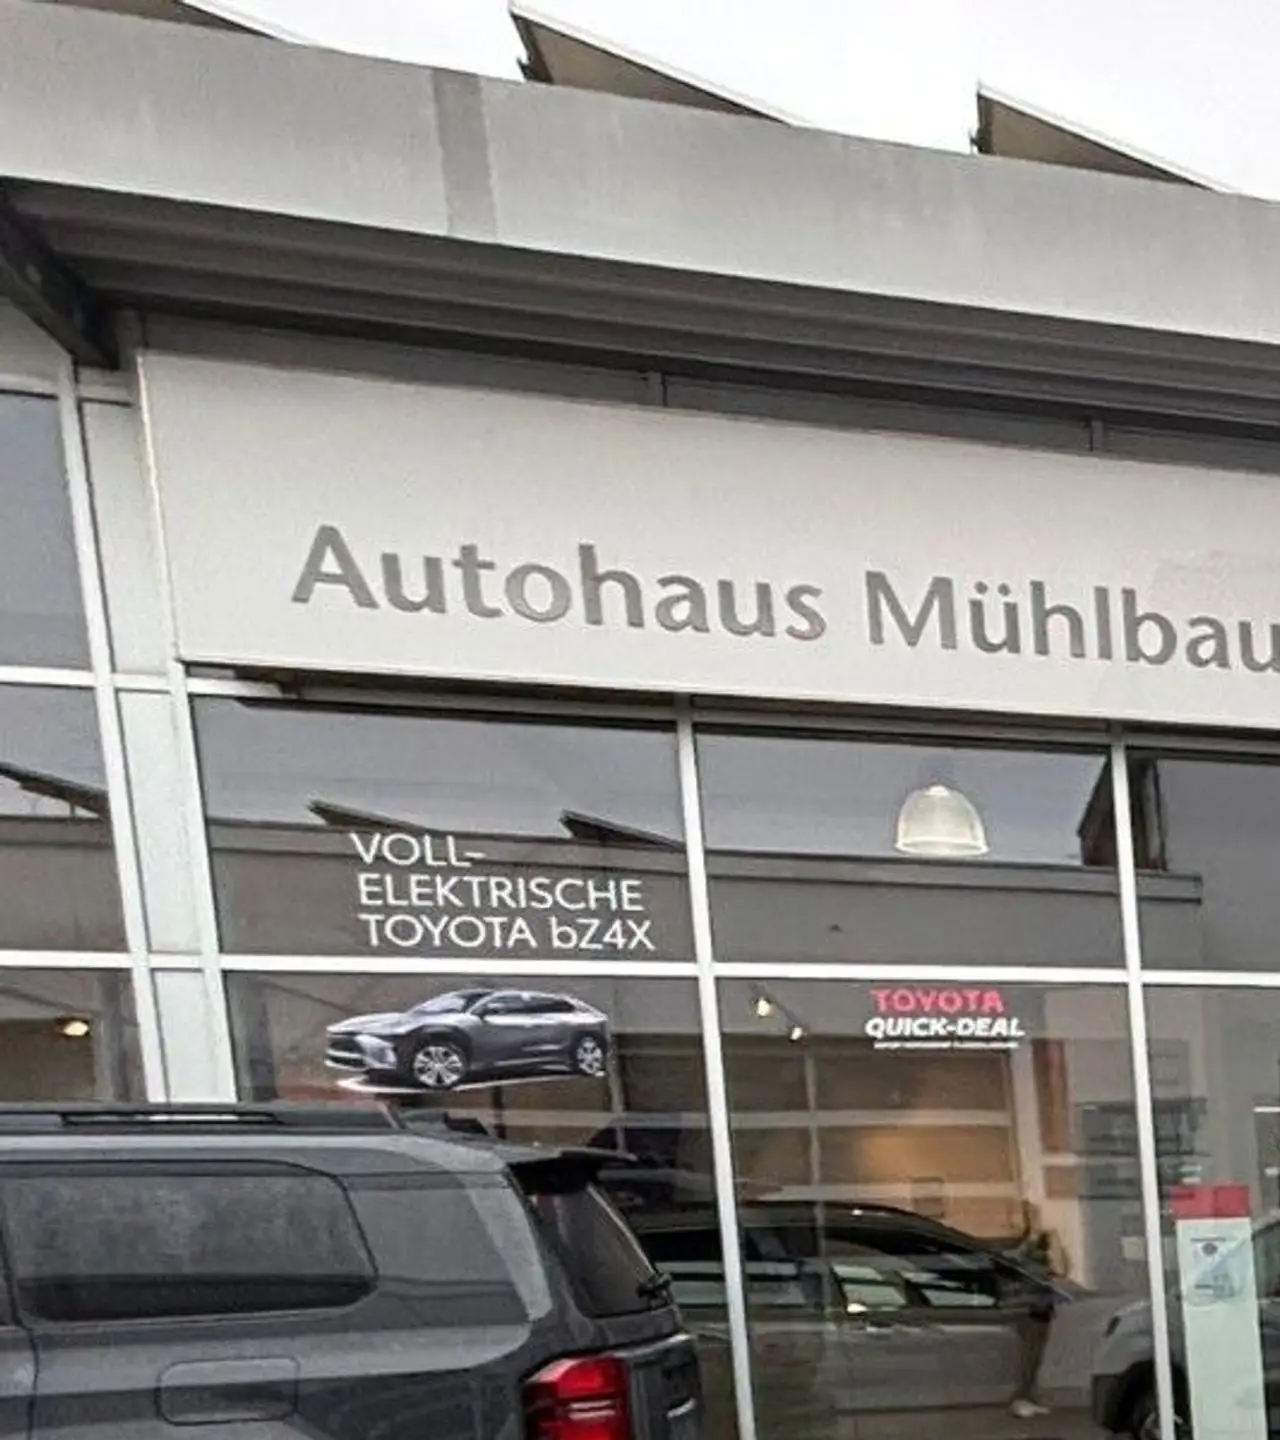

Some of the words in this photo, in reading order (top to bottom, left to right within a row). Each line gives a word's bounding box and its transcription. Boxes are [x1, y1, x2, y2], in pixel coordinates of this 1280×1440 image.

[291, 525, 827, 641] Autohaus
[350, 832, 486, 868] VOLL-
[357, 873, 644, 911] ELEKTRISCHE
[358, 914, 537, 948] TOYOTA
[550, 916, 655, 951] bZ4X
[870, 988, 1004, 1013] TOYOTA
[865, 1016, 1026, 1039] QUICK-DEAL
